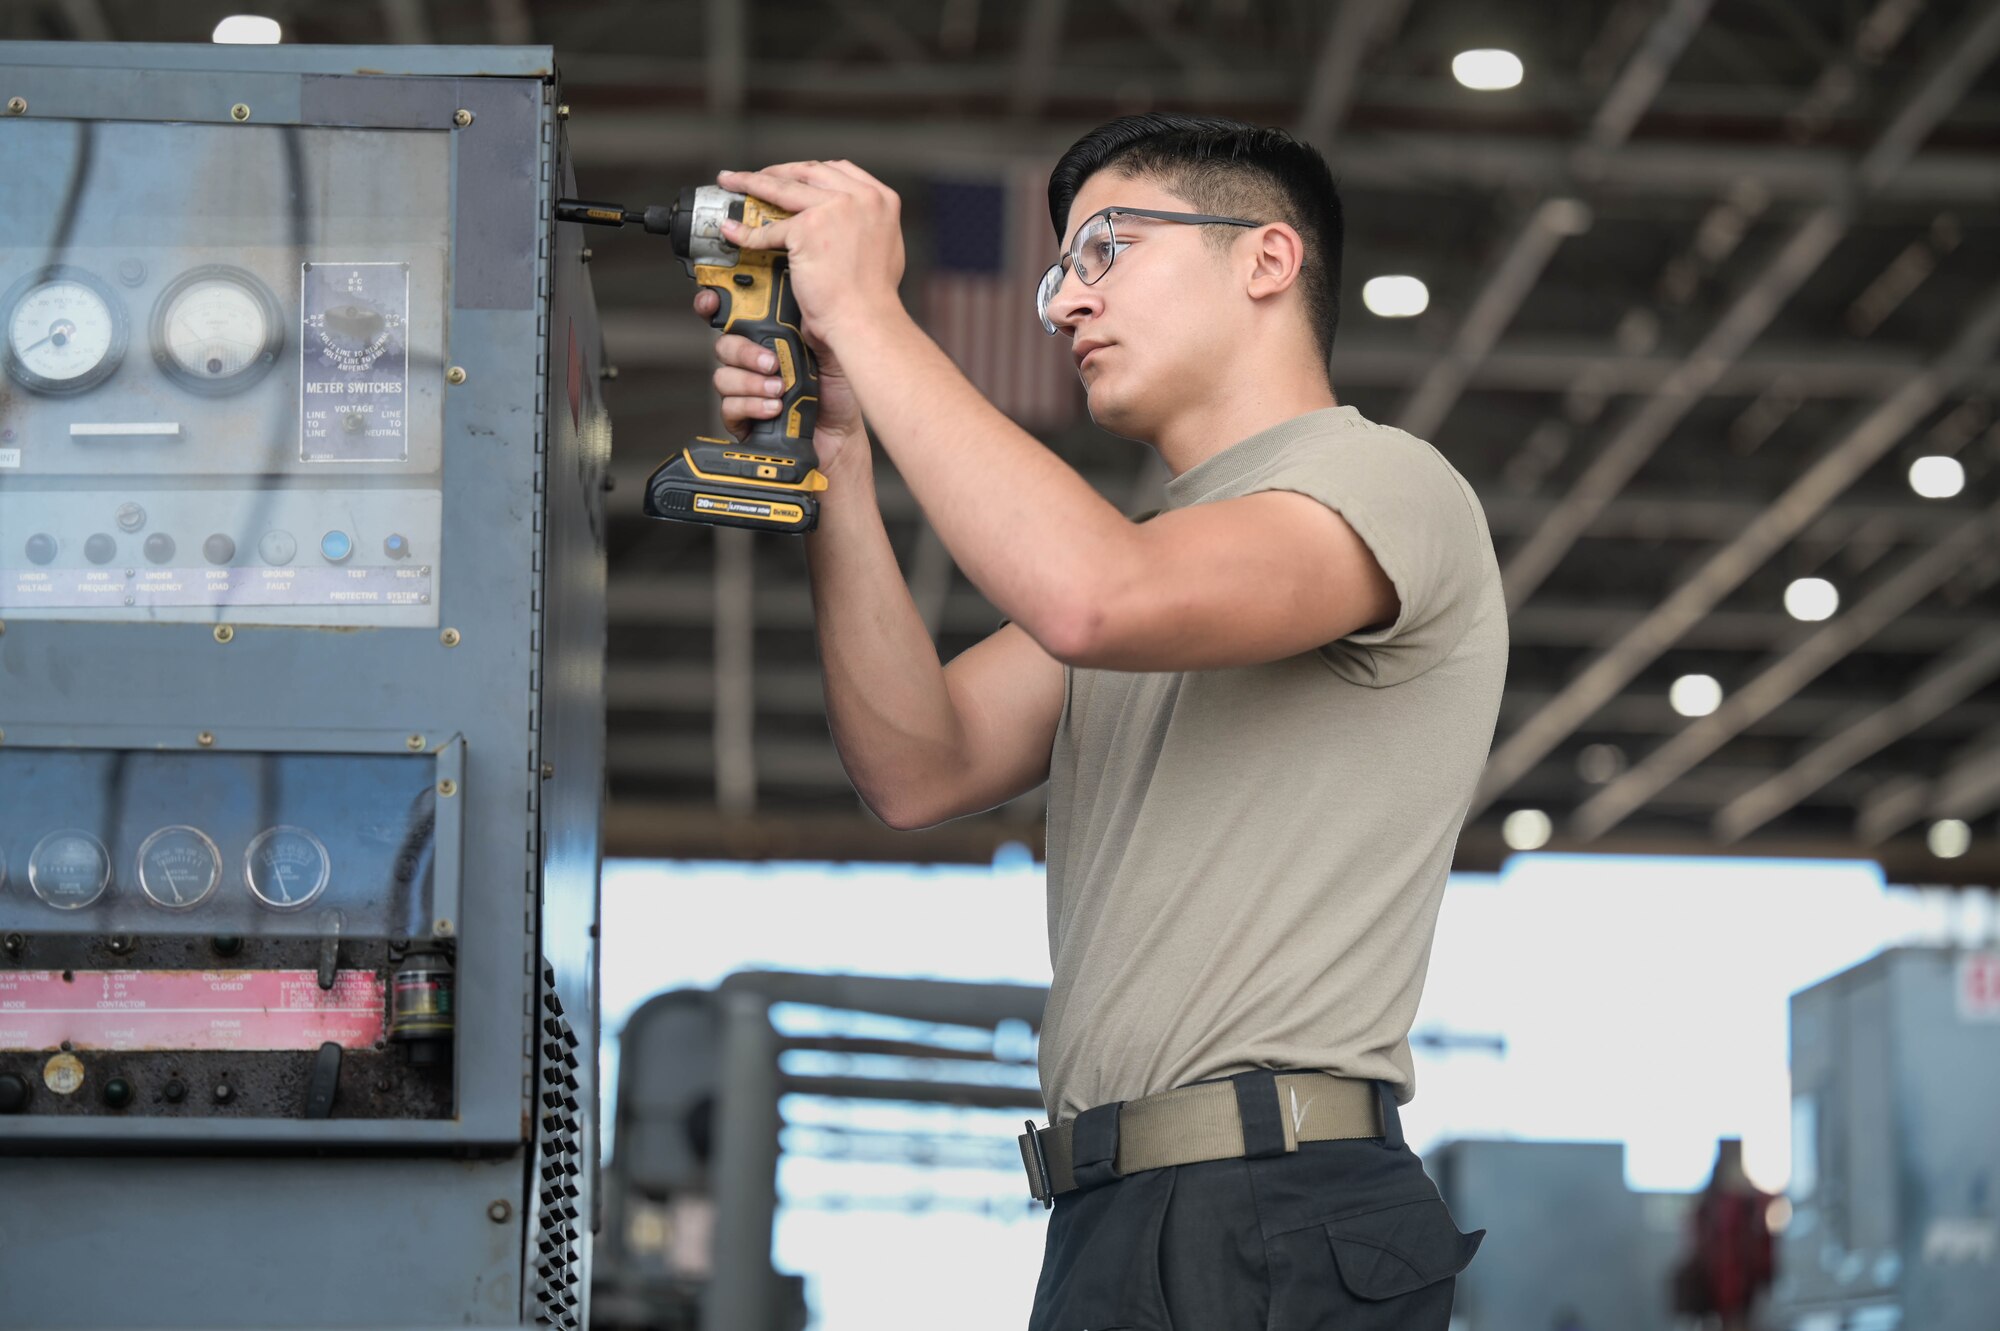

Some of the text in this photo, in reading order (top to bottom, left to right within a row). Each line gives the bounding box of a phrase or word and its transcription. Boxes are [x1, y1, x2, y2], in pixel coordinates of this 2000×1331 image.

[337, 363, 370, 372] AMPERES
[306, 382, 402, 394] METER SWITCHES
[334, 405, 374, 413] VOLTAGE
[306, 411, 327, 419] LINE
[381, 410, 401, 418] LINE
[307, 420, 319, 428] TO
[389, 419, 402, 427] TO
[306, 429, 327, 437] LINE
[364, 429, 401, 437] NEUTRAL
[262, 570, 296, 579] GROUND
[347, 569, 368, 578] TEST
[16, 583, 53, 592] VOLTAGE
[77, 583, 125, 593] FREQUENCY
[136, 583, 183, 592] FREQUENCY
[207, 582, 230, 591] LOAD
[266, 582, 292, 591] FAULT
[329, 591, 419, 600] PROTECTIVE SYSTEM
[18, 973, 50, 981] VOLTAGE
[210, 983, 244, 991] CLOSED
[3, 1001, 27, 1009] MODE
[96, 1000, 147, 1009] CONTACTOR
[210, 1020, 241, 1028] ENGINE
